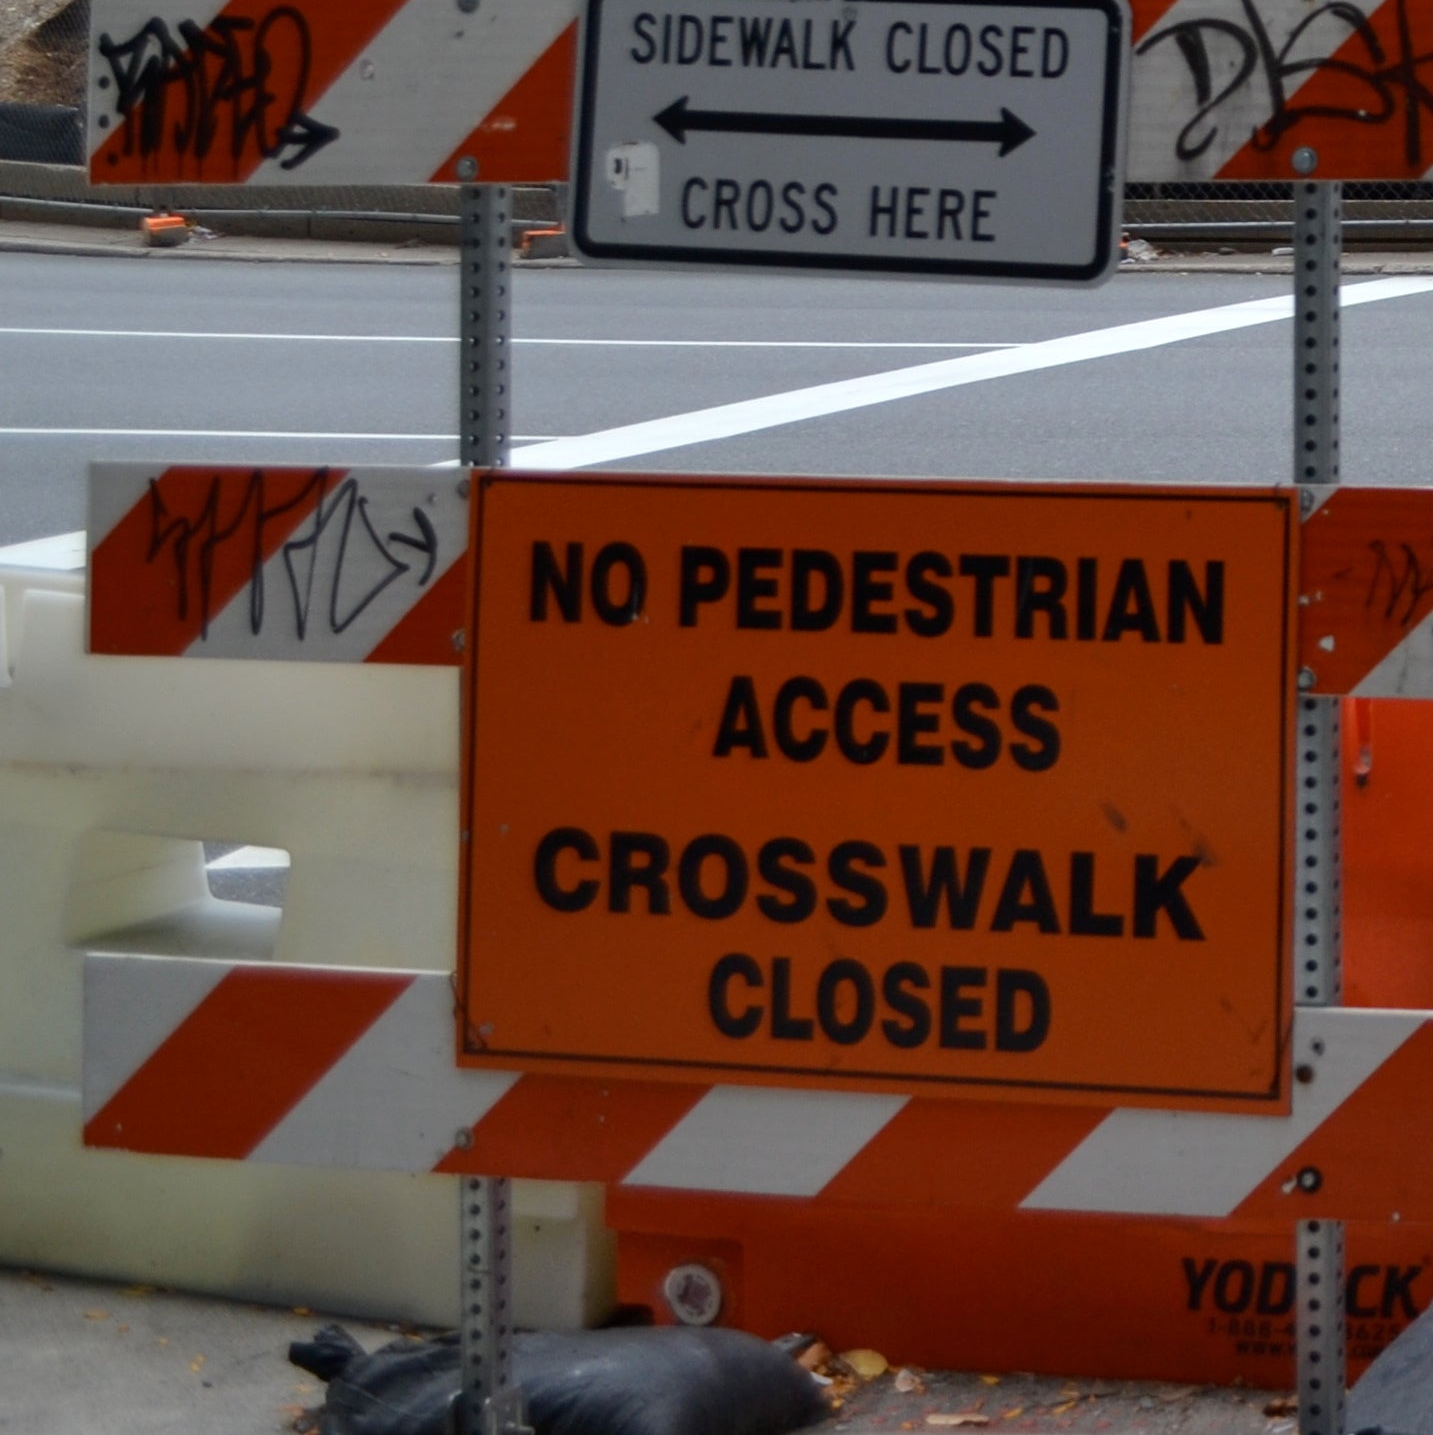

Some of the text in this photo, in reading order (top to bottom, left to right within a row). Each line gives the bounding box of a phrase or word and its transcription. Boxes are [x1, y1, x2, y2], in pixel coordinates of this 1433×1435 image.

[631, 12, 1069, 78] SIDEWALK CLOSED
[681, 177, 997, 242] CROSS HERE
[529, 540, 648, 626] NO
[679, 545, 1224, 645] PEDESTRIAN
[713, 676, 1060, 771] ACCESS
[534, 827, 1206, 942] CROSSWALK
[708, 953, 1051, 1053] CLOSED
[1183, 1259, 1423, 1318] YODCK
